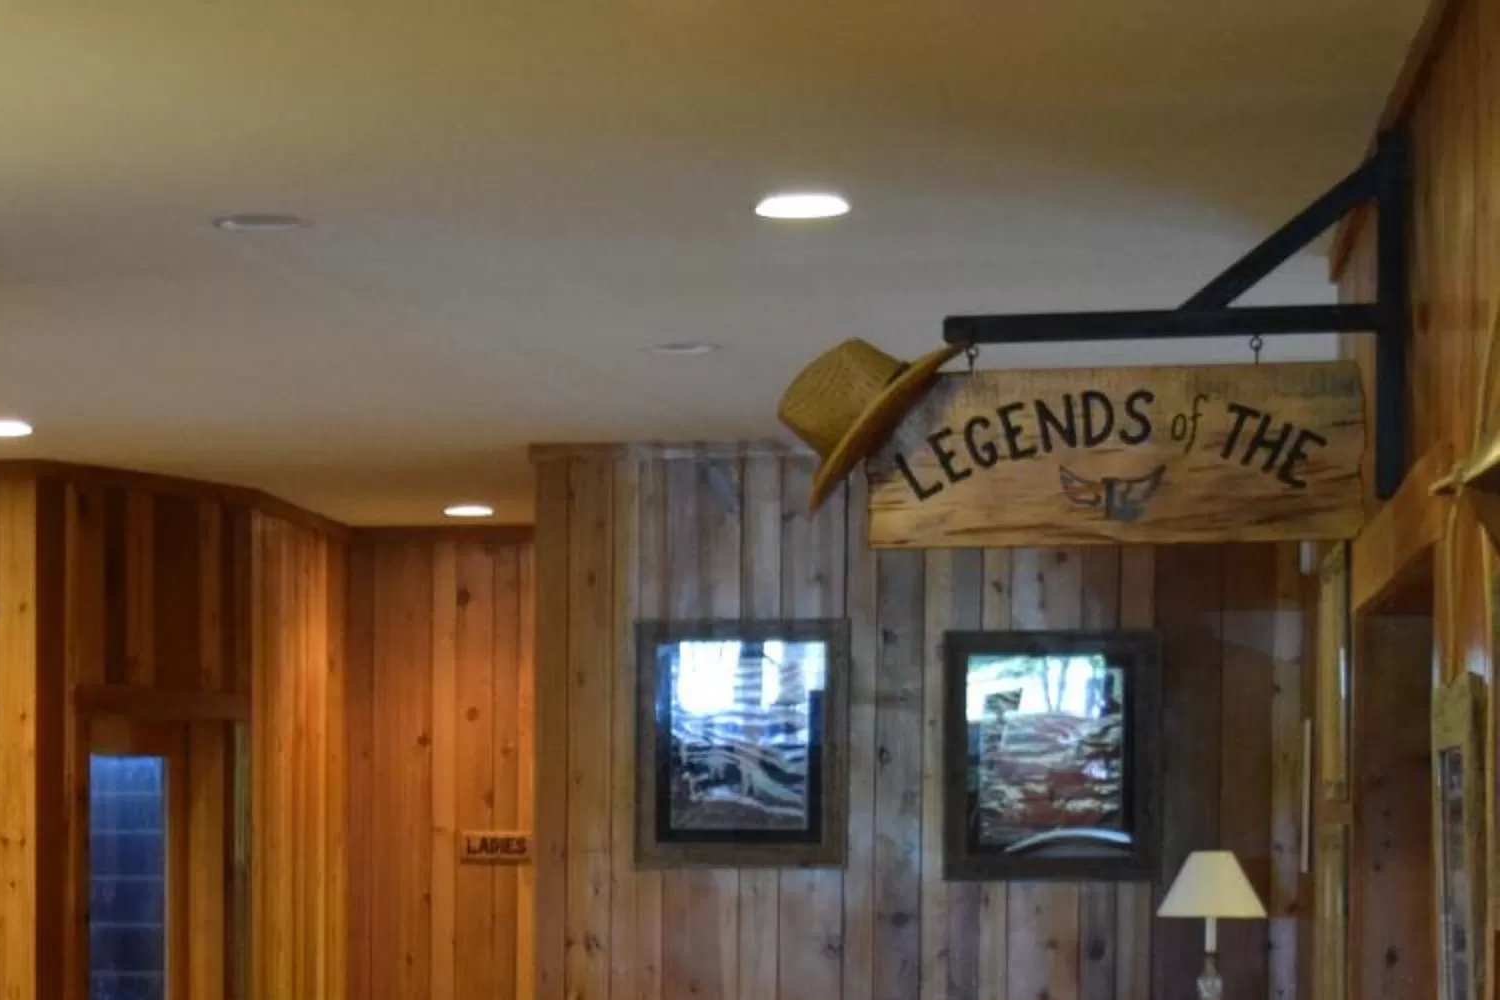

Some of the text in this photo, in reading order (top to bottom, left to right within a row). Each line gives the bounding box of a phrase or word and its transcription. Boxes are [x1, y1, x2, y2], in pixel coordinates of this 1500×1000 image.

[895, 389, 1327, 502] LEGENDS of THE
